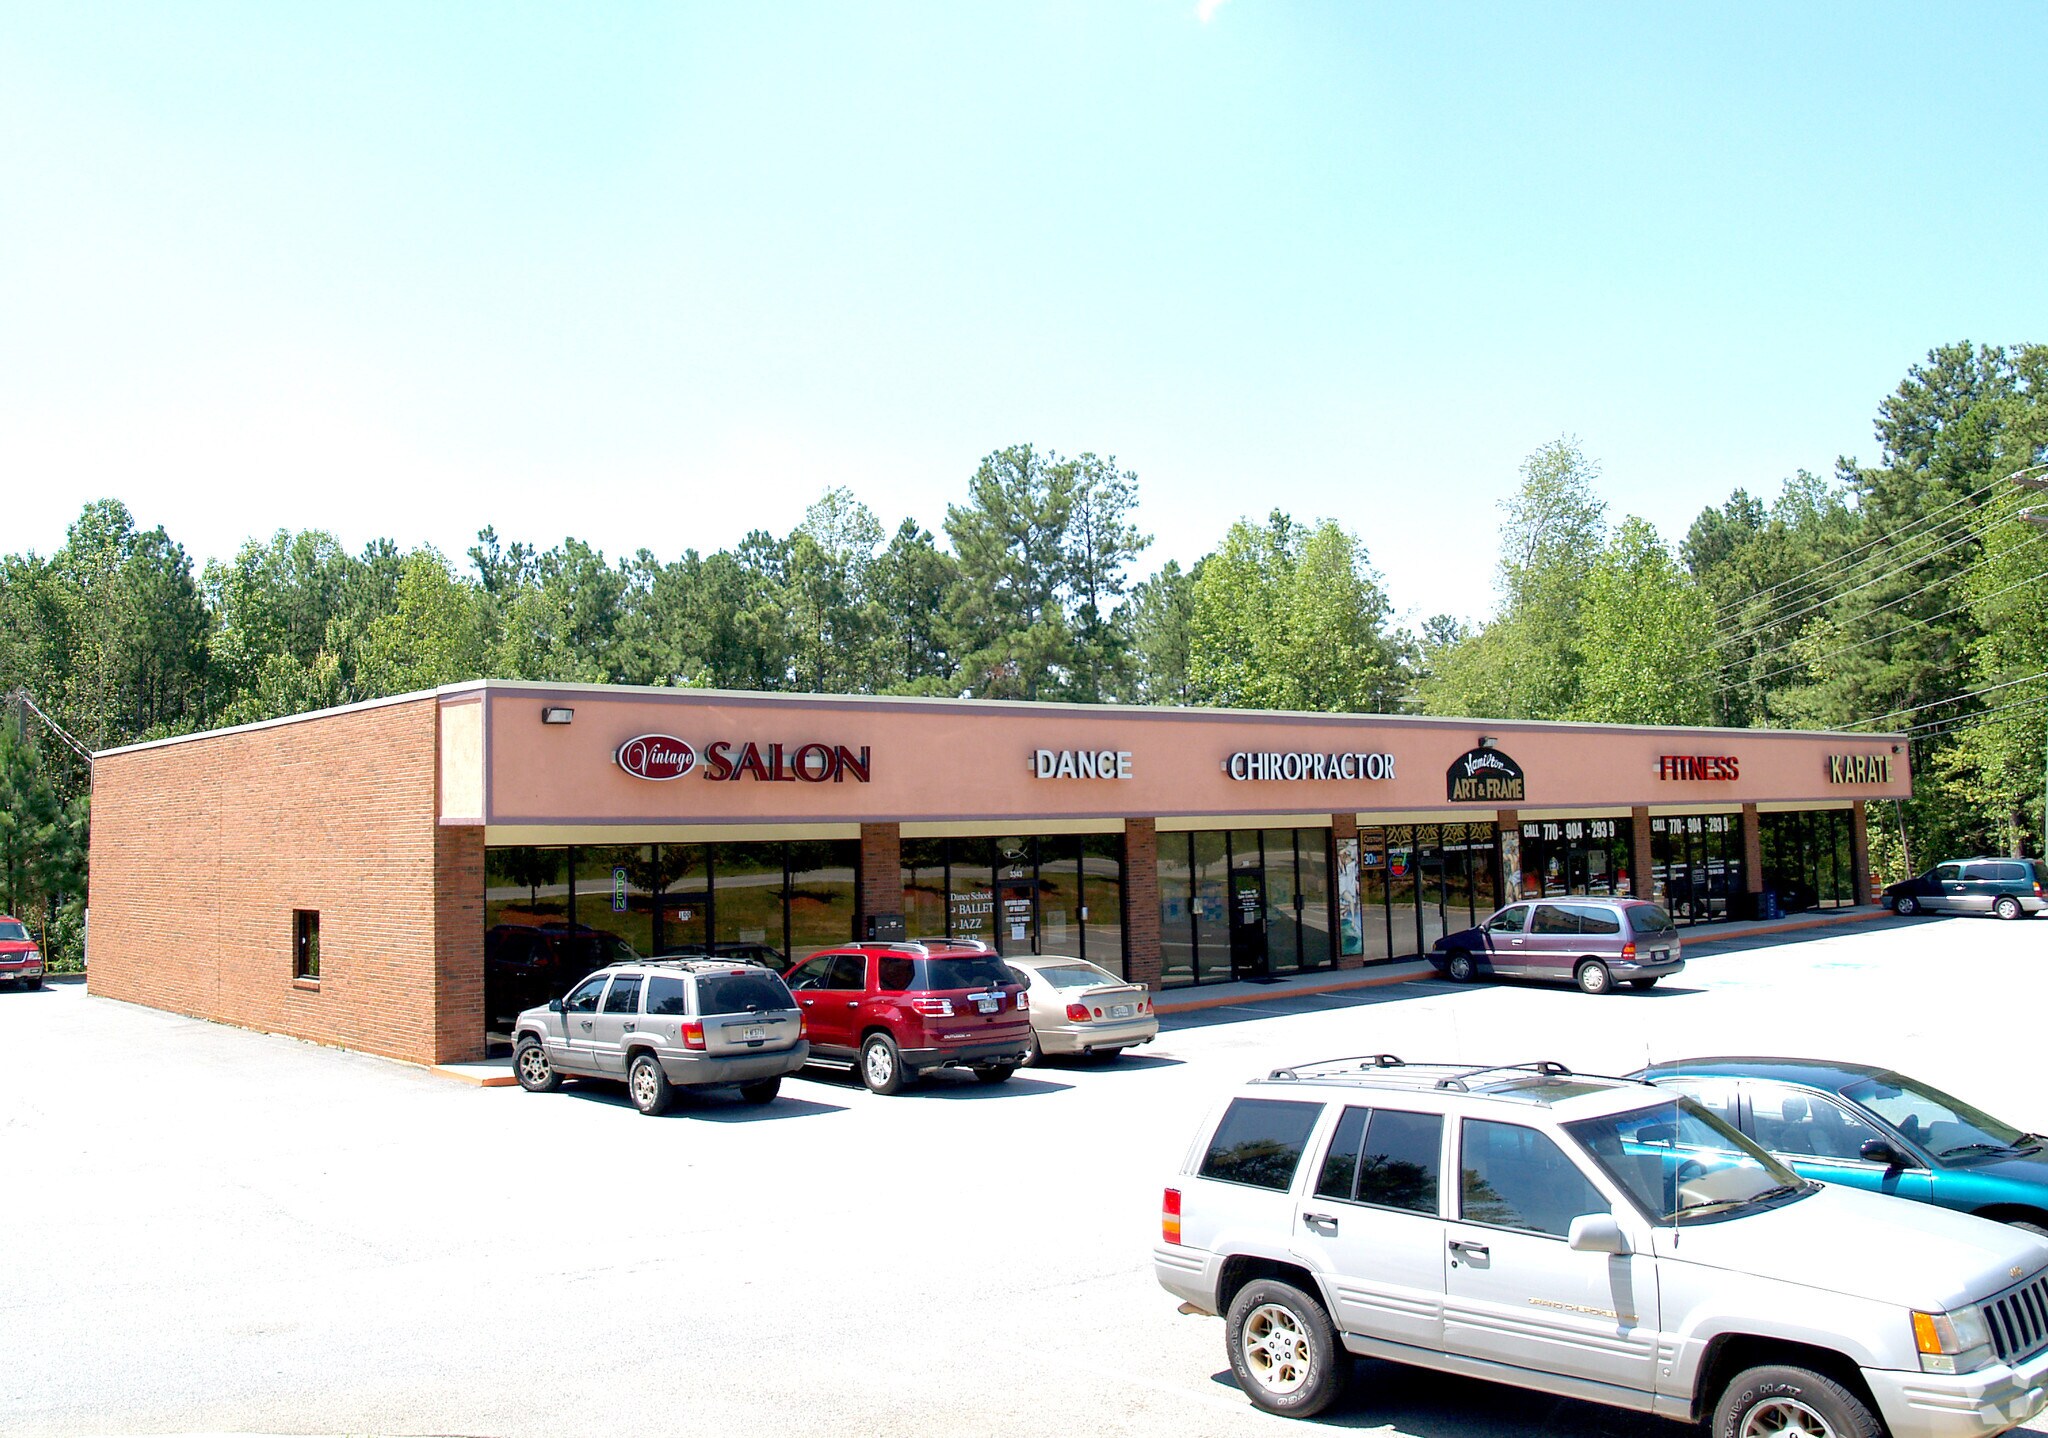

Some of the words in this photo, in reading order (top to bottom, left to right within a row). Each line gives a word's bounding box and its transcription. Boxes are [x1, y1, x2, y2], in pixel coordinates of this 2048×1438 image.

[627, 741, 692, 775] Vintage
[704, 742, 871, 783] SALON
[1035, 750, 1132, 779] DANCE
[1229, 752, 1395, 780] CHIROPRACTOR
[1464, 753, 1515, 776] Hamilton
[1660, 756, 1739, 781] FITNESS
[1830, 755, 1894, 783] KARATE
[1453, 777, 1477, 799] ART
[1478, 783, 1485, 796] &
[1486, 777, 1522, 798] FRAME
[1523, 824, 1540, 837] CALL
[1652, 819, 1666, 832] CALL
[615, 869, 626, 909] OPEN
[950, 893, 970, 901] Dance
[959, 902, 994, 914] BALLET
[959, 918, 982, 930] JAZZ
[1724, 1390, 1753, 1438] RAVO
